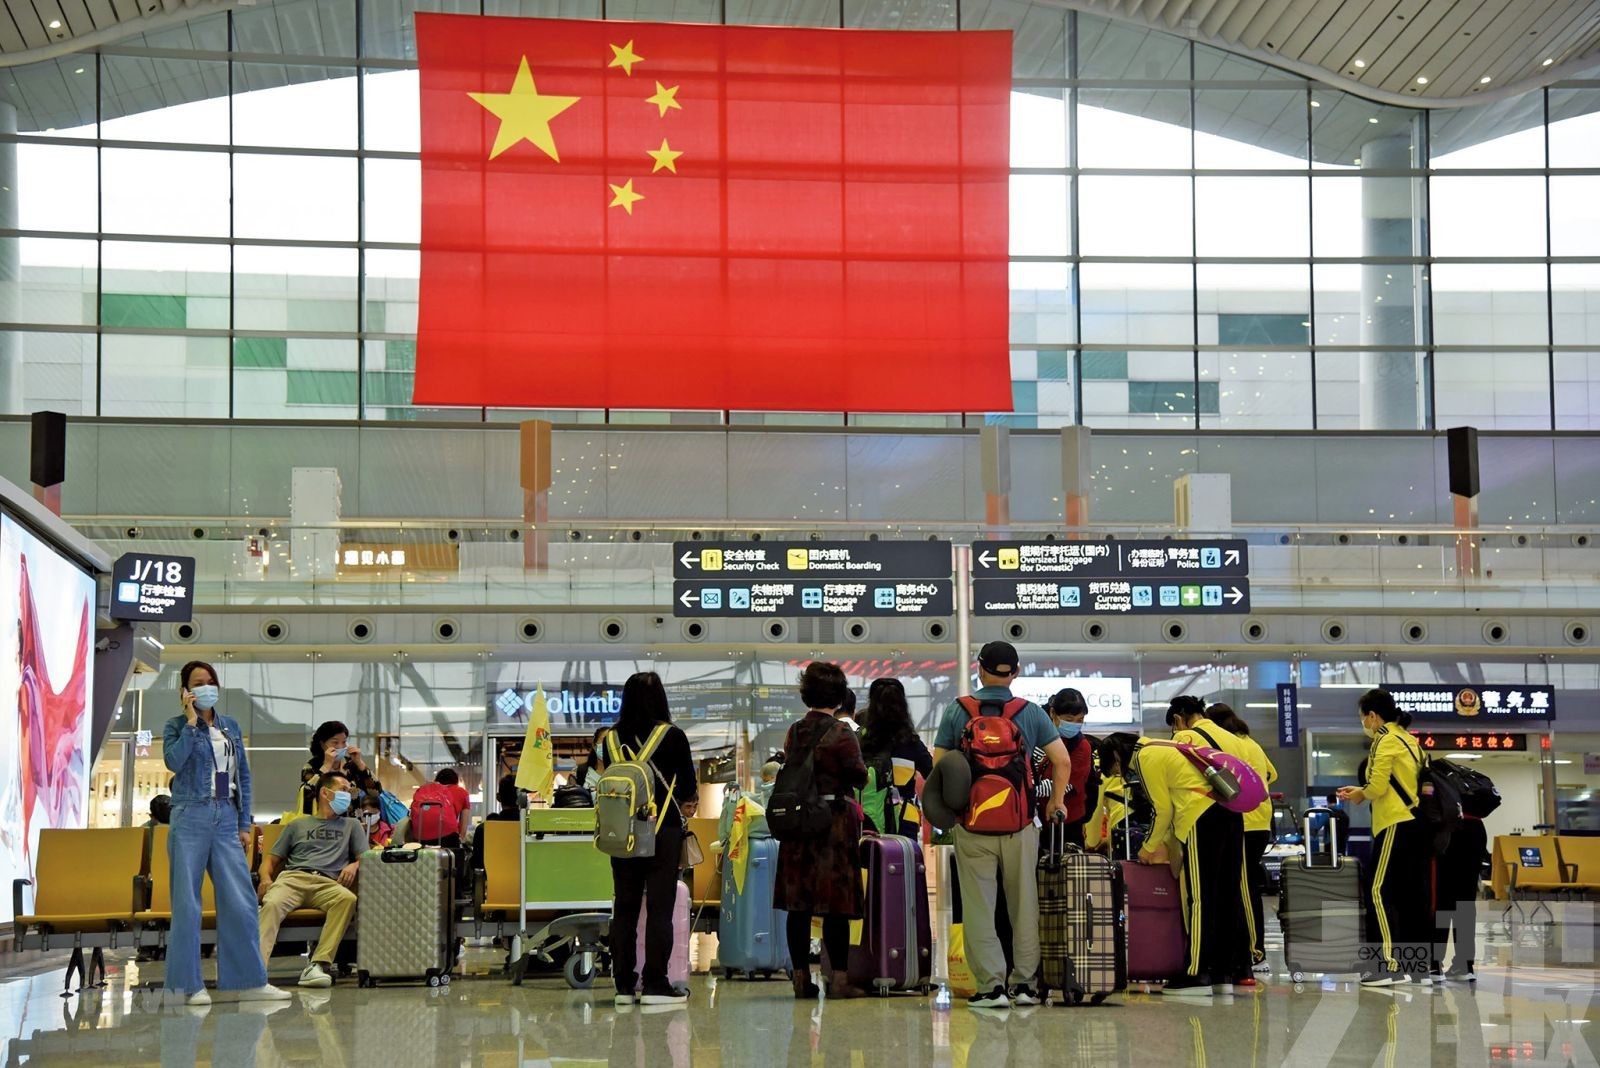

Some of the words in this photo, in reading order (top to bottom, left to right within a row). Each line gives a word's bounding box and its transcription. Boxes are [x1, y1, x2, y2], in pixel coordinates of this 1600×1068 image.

[723, 550, 766, 562] 安全检查
[1168, 548, 1199, 560] 警务室
[1059, 557, 1093, 565] Baggage
[1176, 561, 1200, 569] Police
[129, 559, 182, 583] J/18
[723, 562, 754, 572] Security
[756, 562, 780, 571] Check
[808, 562, 844, 571] Domestic
[846, 562, 882, 572] Boarding
[140, 596, 176, 606] Baggage
[751, 597, 767, 605] Lost
[769, 597, 785, 605] and
[823, 597, 858, 606] Baggage
[896, 596, 928, 605] Business
[1017, 594, 1031, 602] Tax
[1034, 594, 1059, 602] Refund
[1097, 595, 1131, 605] Currency
[139, 605, 164, 614] Check
[823, 605, 854, 613] Deposit
[896, 604, 922, 612] Center
[985, 602, 1016, 610] Customs
[1017, 602, 1059, 610] Verification
[1095, 603, 1131, 612] Exchange
[1087, 693, 1122, 708] CGB
[1482, 691, 1549, 707] 警务室
[1456, 736, 1514, 748] 牢记使命
[307, 828, 343, 840] KEEP
